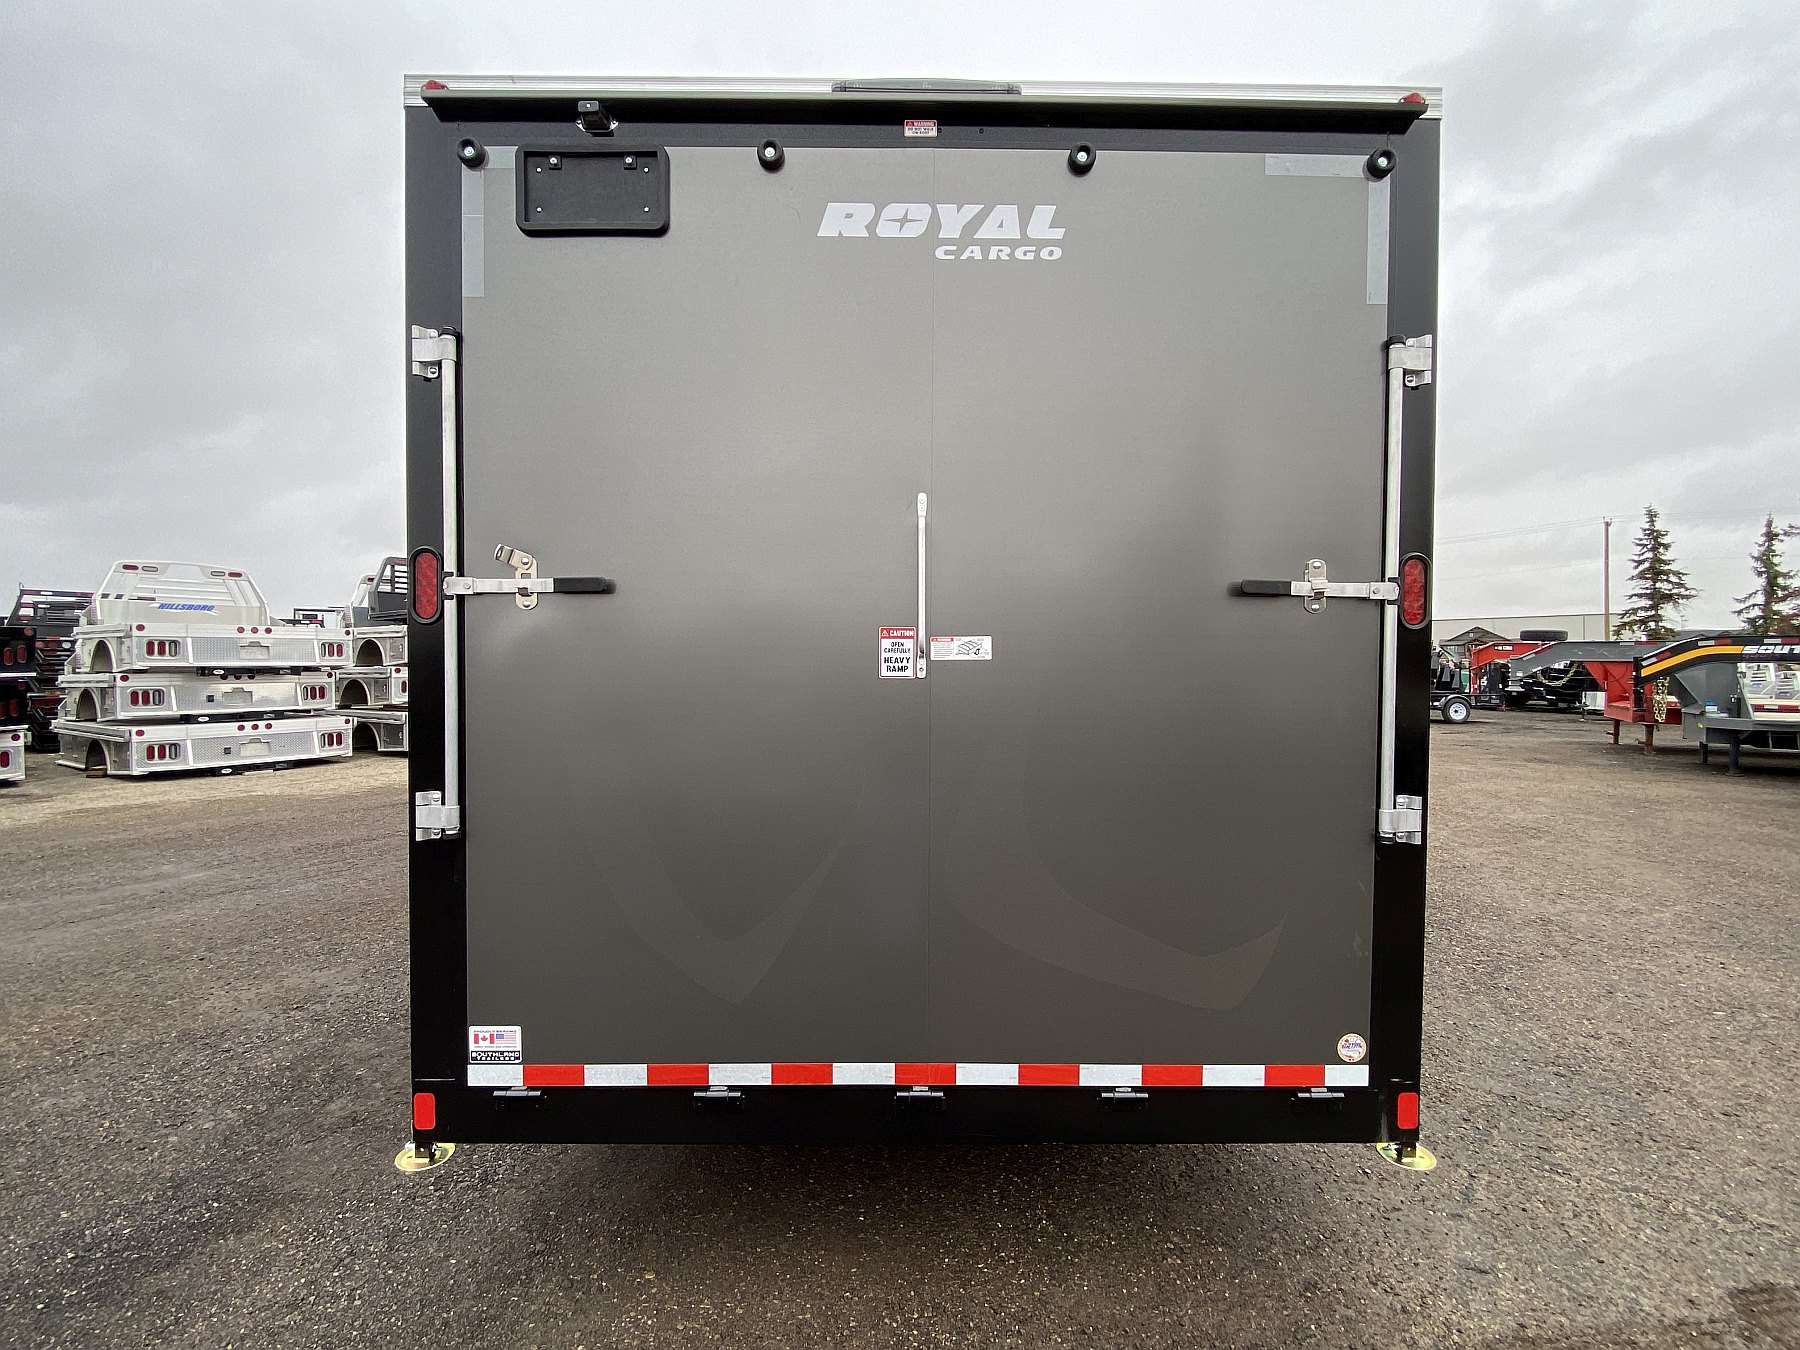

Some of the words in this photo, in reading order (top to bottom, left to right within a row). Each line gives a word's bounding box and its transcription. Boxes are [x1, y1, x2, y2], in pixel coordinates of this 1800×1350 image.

[816, 202, 1066, 239] ROYAL
[934, 245, 1063, 261] CARGO
[158, 602, 215, 612] HILLSBORO
[884, 656, 911, 664] HEAVY
